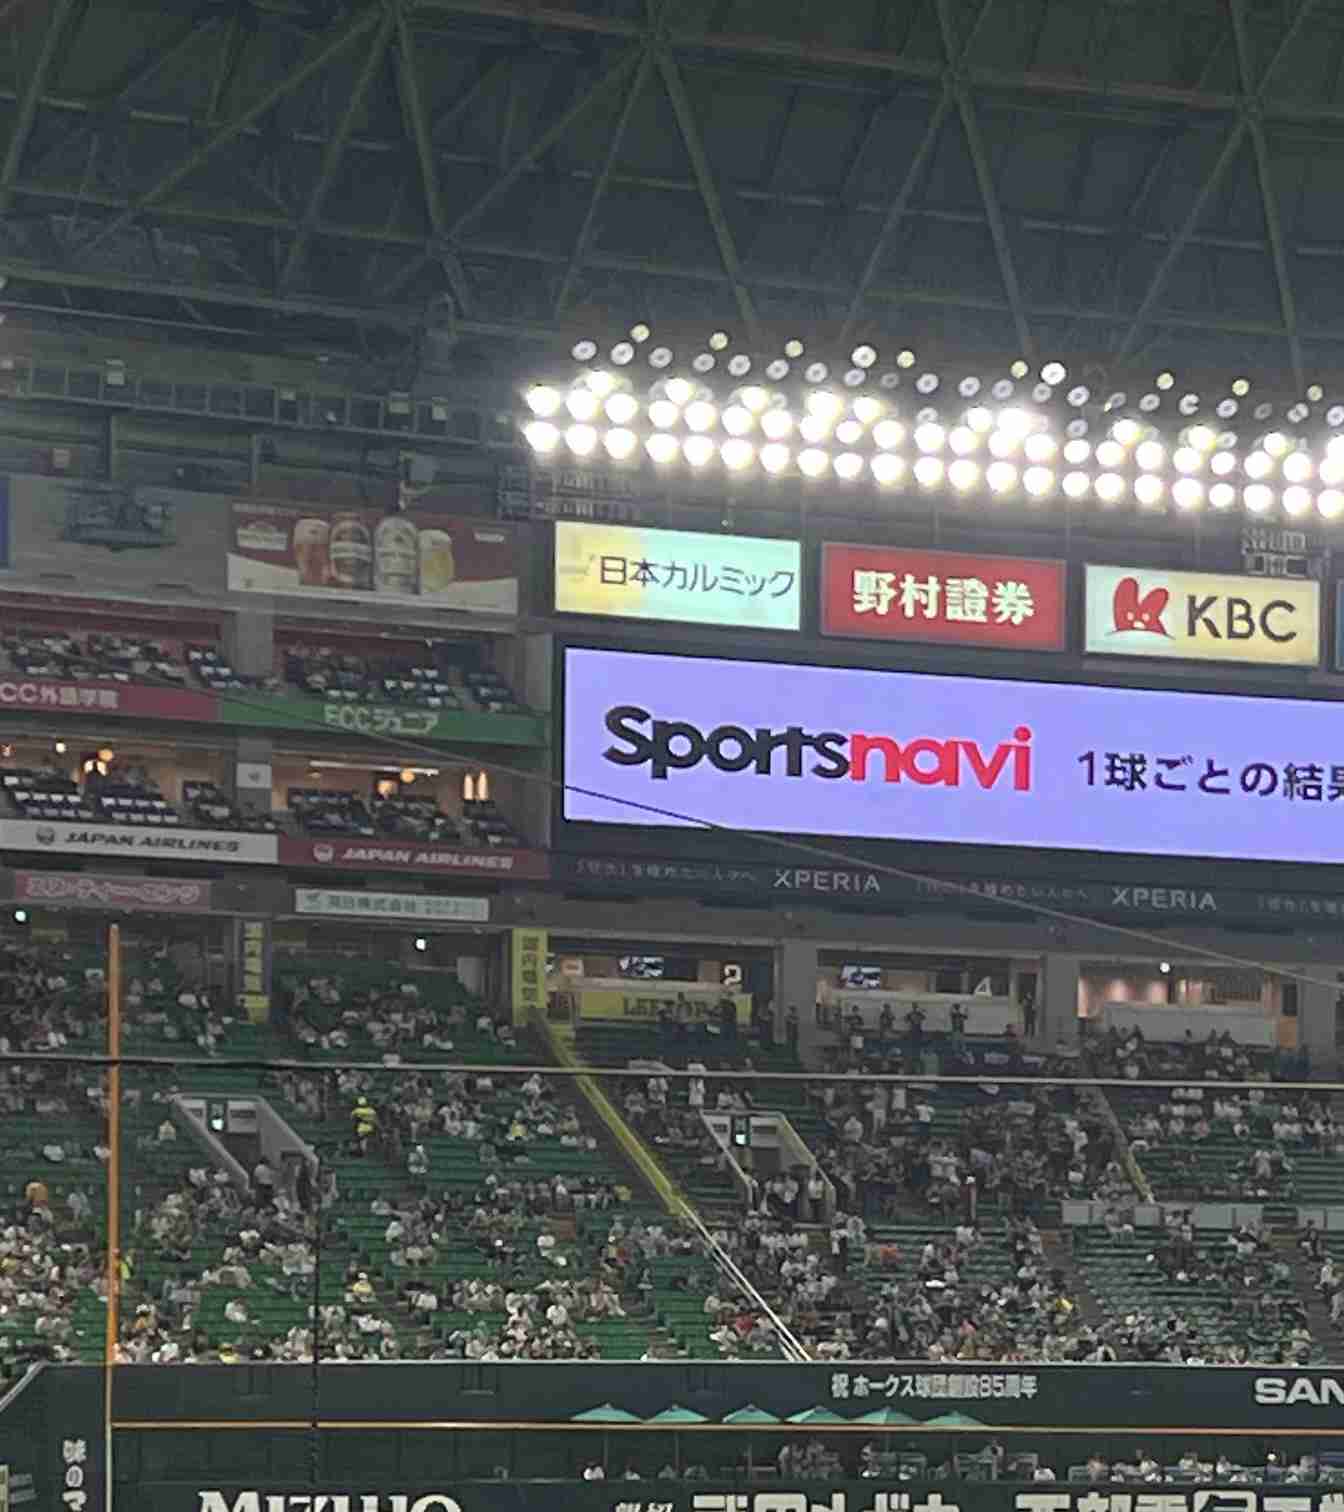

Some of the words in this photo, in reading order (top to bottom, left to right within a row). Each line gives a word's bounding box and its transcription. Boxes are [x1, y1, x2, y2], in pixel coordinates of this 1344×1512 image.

[600, 555, 796, 600] 日本カルミック
[851, 567, 1035, 626] 野村證券
[1187, 594, 1299, 644] KBC
[601, 705, 1033, 791] Sportsnavi
[64, 831, 134, 847] JAPAN
[138, 834, 240, 852] AIRLINES
[341, 847, 410, 863] JAPAN
[415, 851, 514, 870] AIRLINES
[773, 867, 881, 894] XPERIA
[1111, 886, 1218, 913] XPERIA
